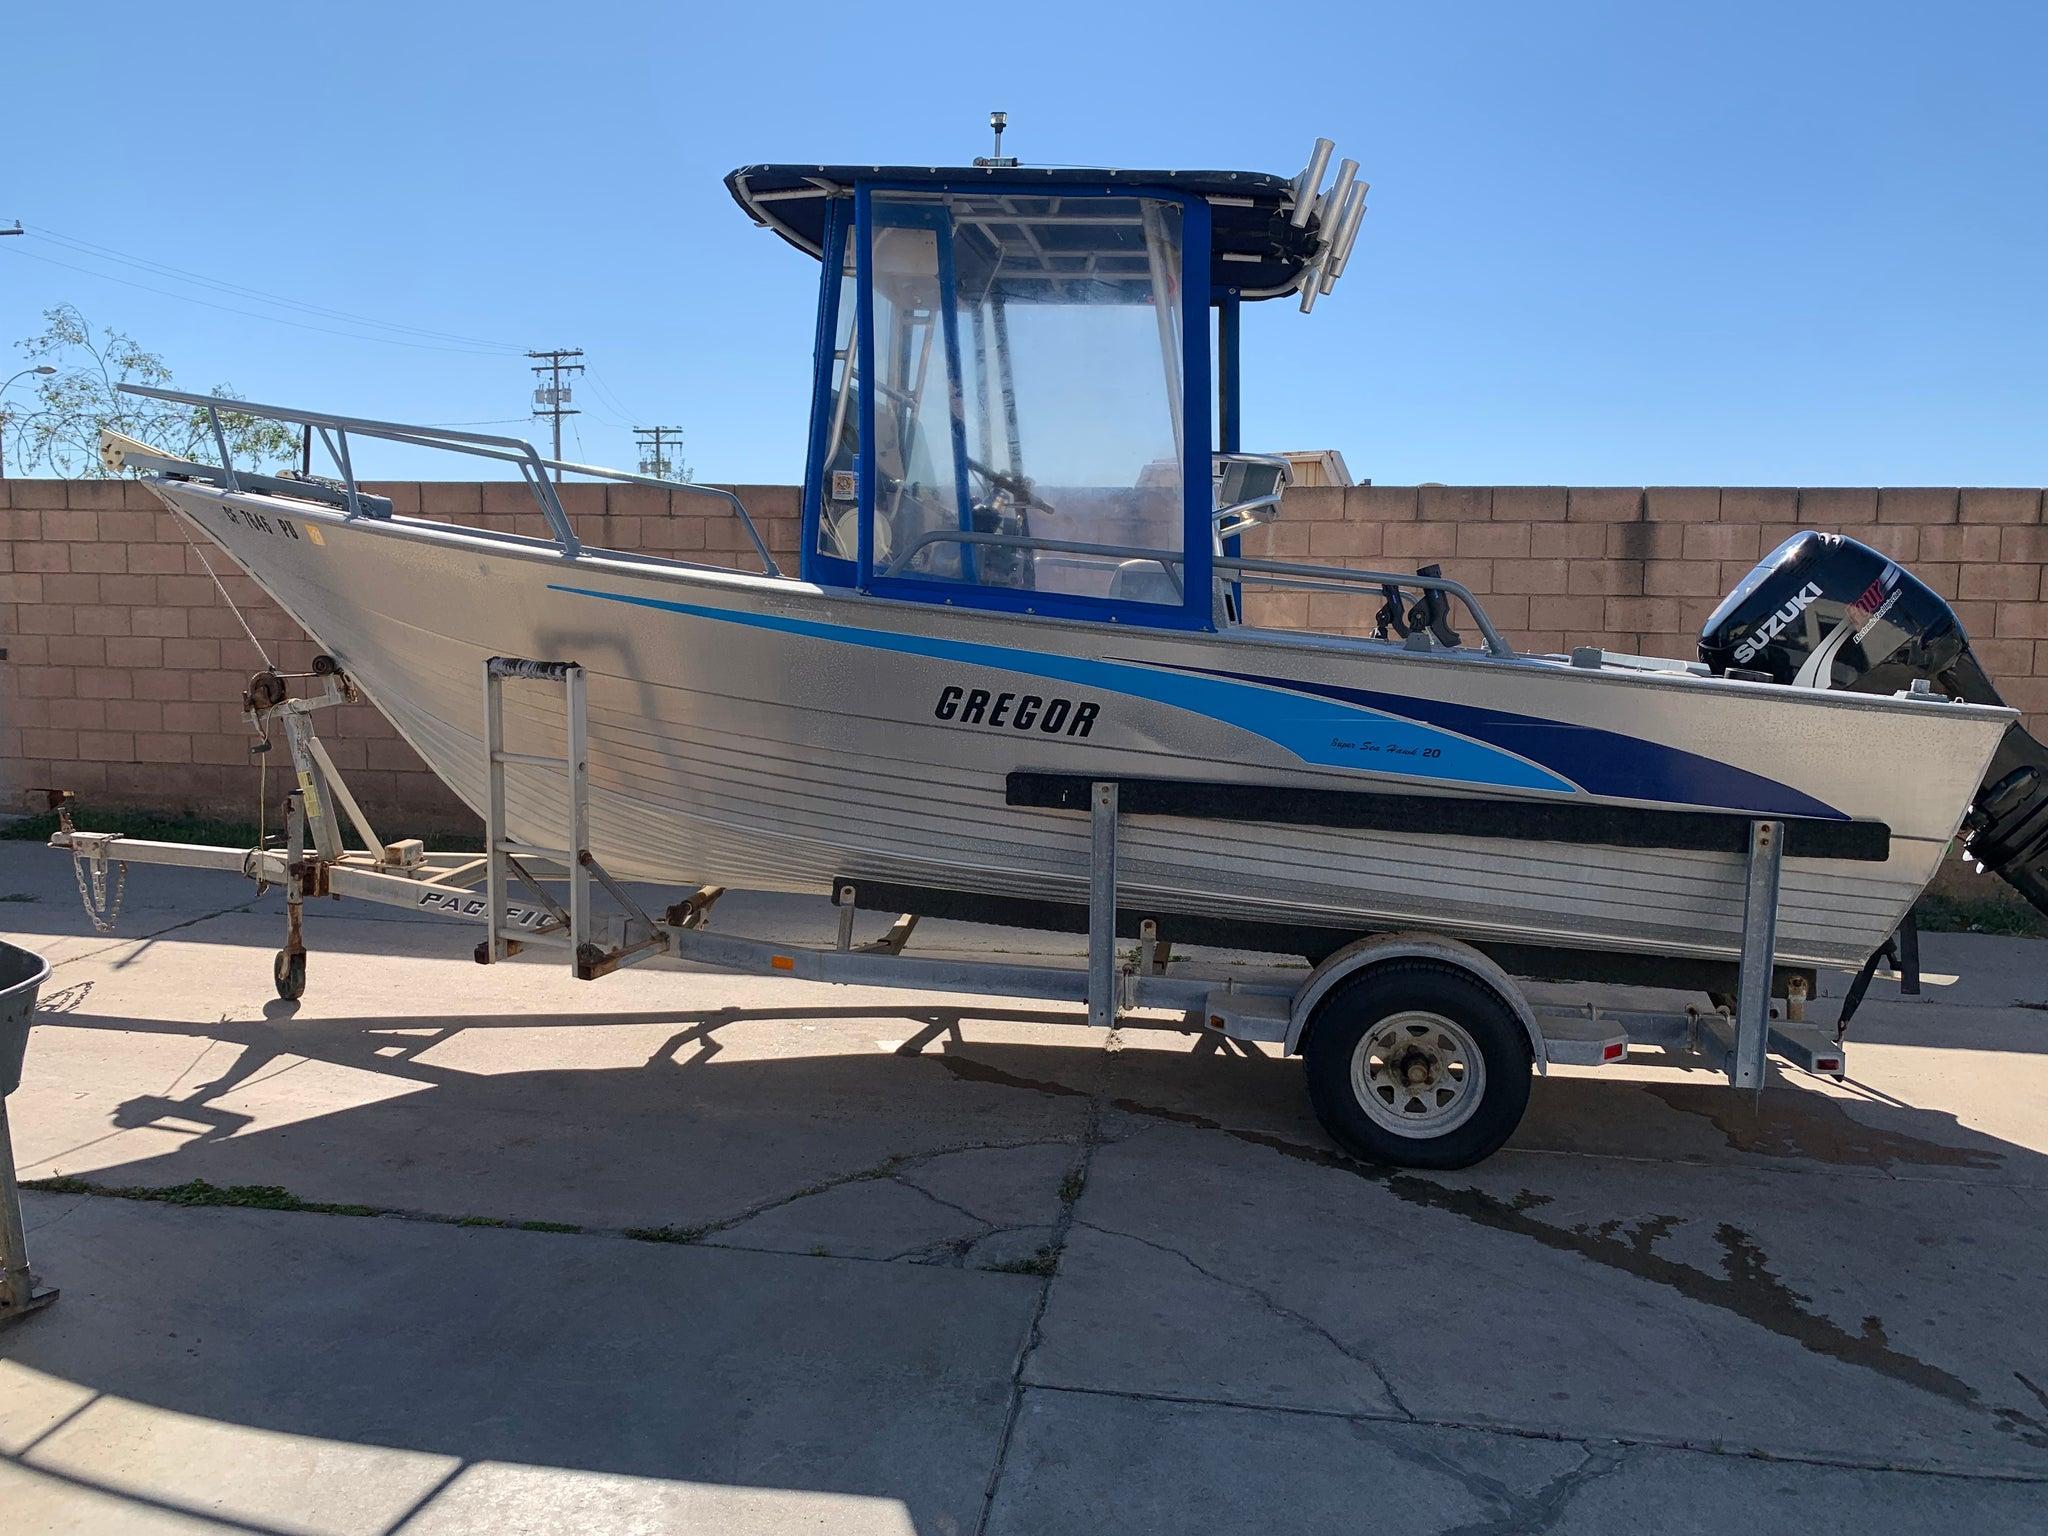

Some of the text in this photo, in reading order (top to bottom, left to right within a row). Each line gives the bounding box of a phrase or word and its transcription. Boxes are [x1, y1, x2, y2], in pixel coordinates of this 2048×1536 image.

[1733, 580, 1824, 664] SUZUKI
[934, 686, 1101, 738] GREGOR
[1331, 736, 1441, 758] Super Sea Hawk 20
[418, 892, 559, 928] PACFIC
